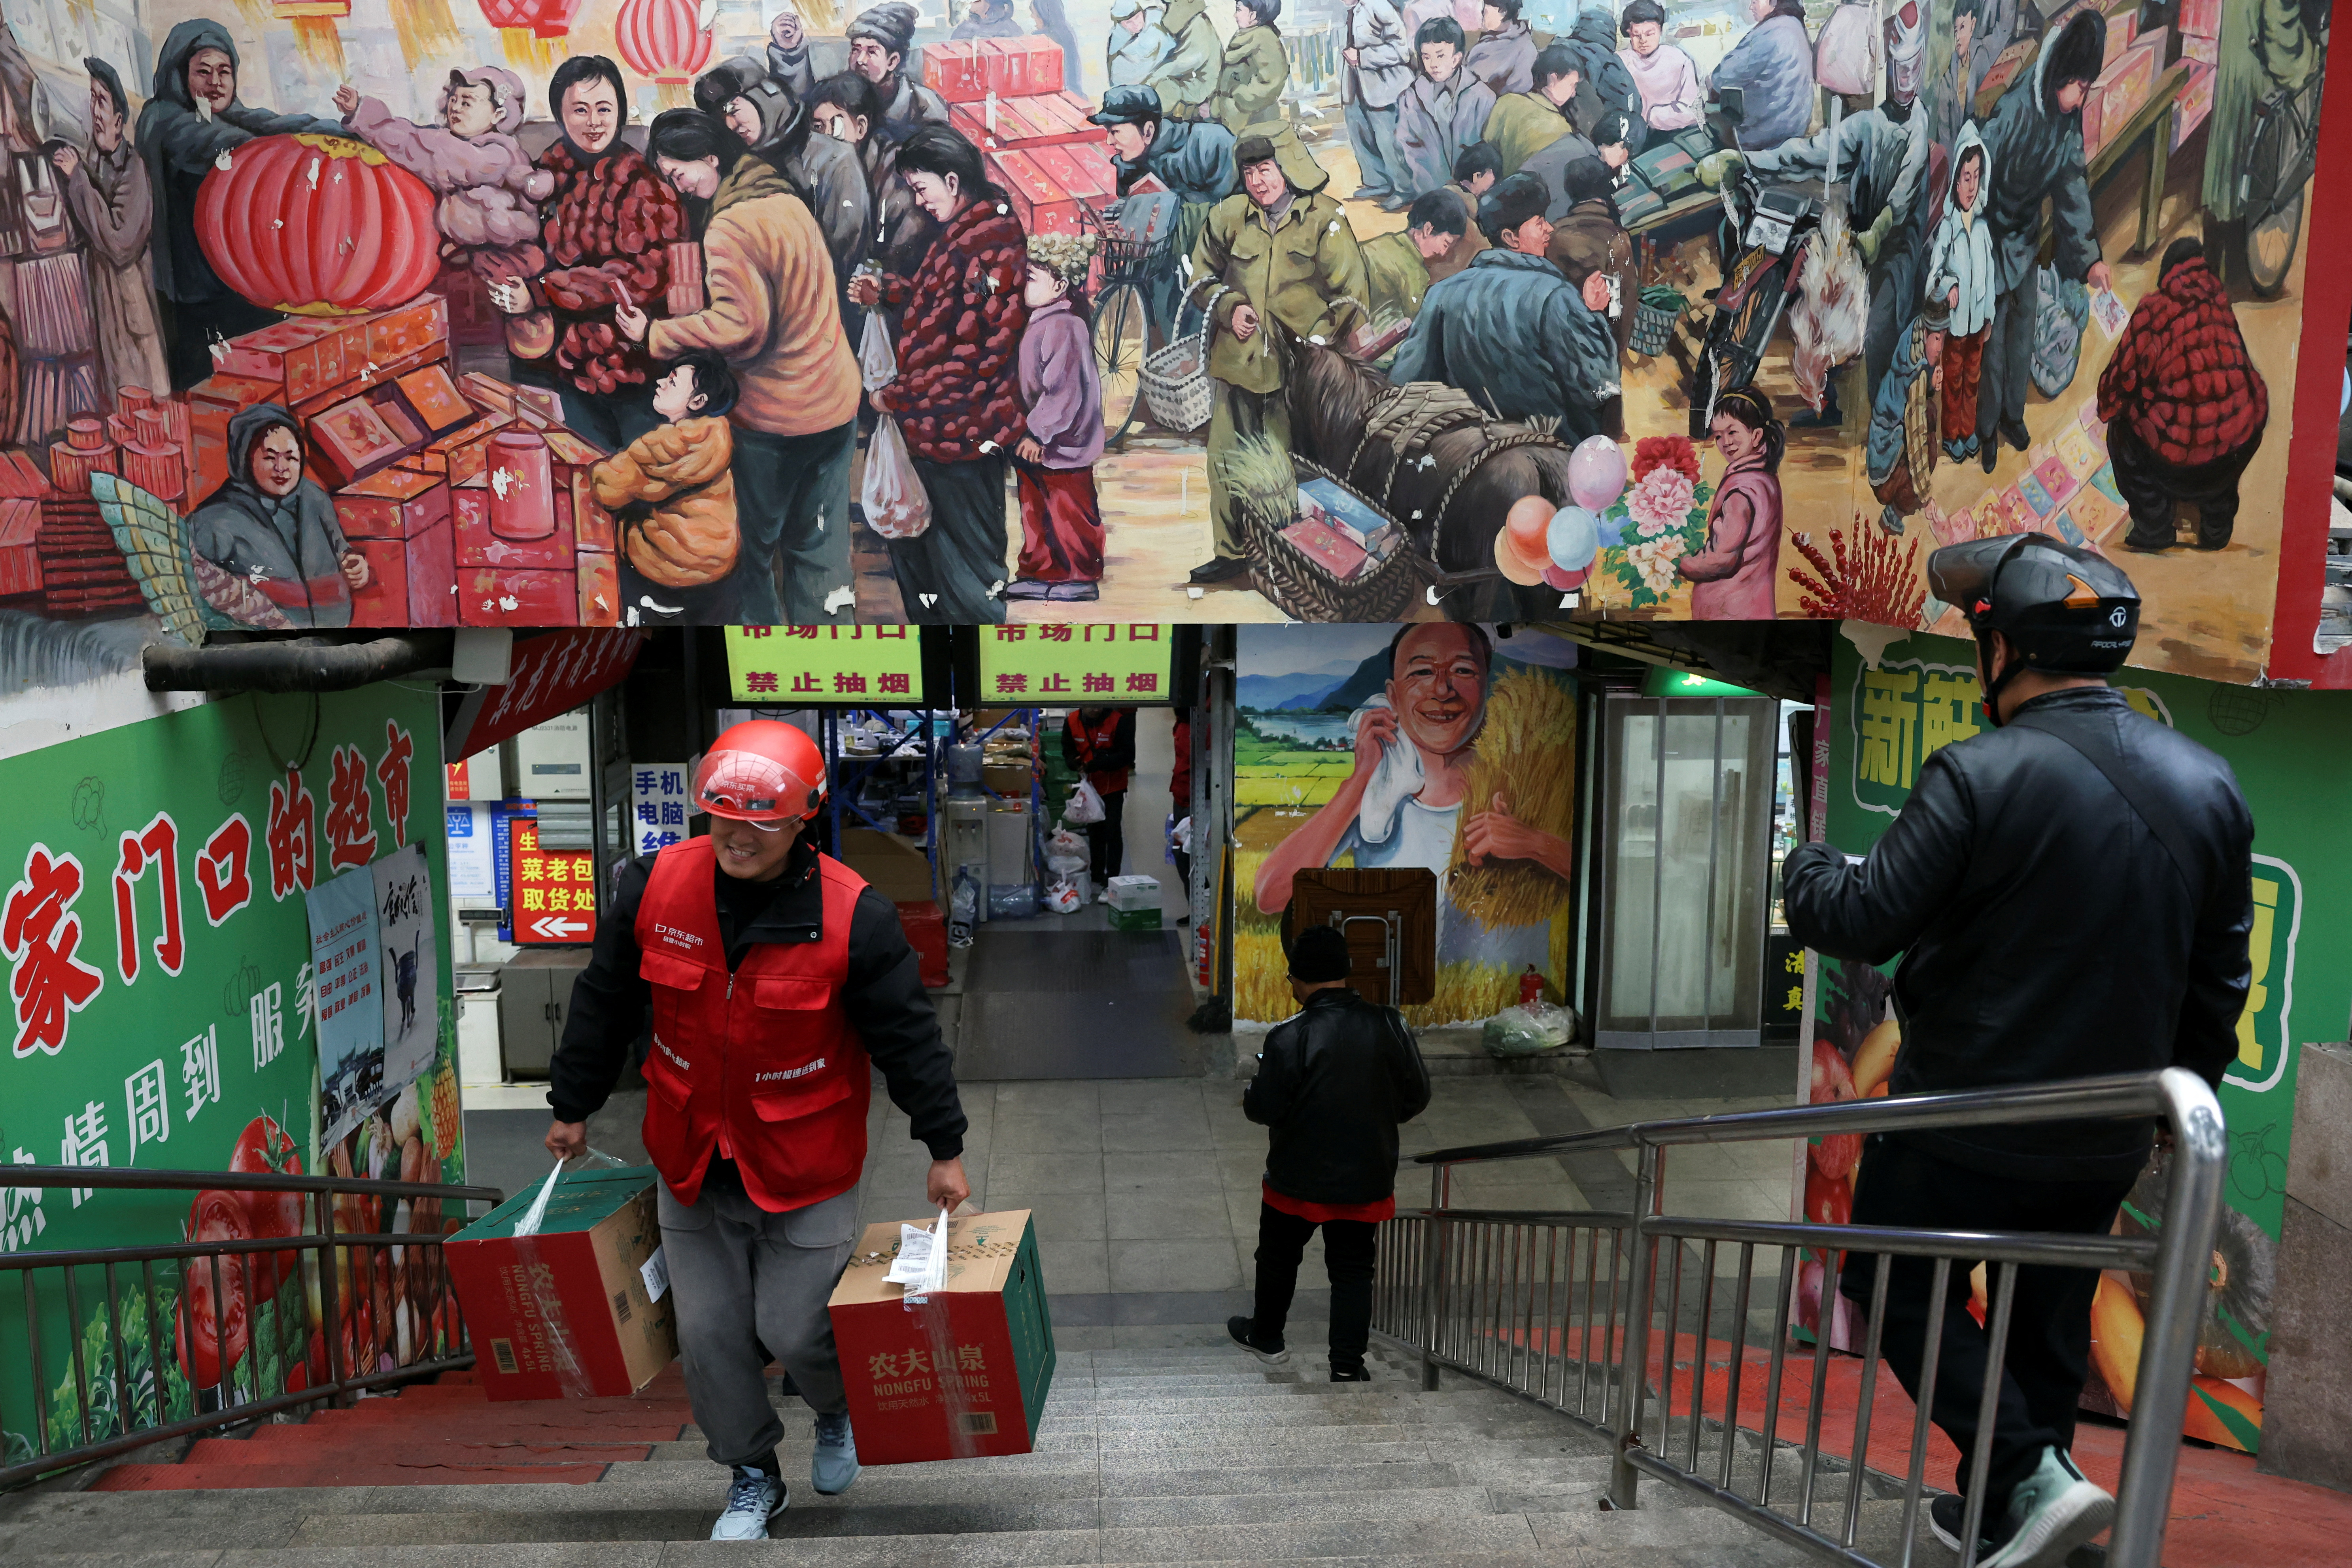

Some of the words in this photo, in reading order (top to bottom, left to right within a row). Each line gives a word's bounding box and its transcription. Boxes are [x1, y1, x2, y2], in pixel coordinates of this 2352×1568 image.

[743, 625, 905, 639] 市场门口
[995, 624, 1158, 642] 市场门口
[746, 672, 909, 693] 禁止抽烟
[996, 673, 1157, 693] 禁止抽烟
[635, 771, 683, 795] 手机
[721, 780, 756, 793] 京东买菜
[638, 801, 684, 825] 电脑
[521, 858, 593, 882] 菜老包
[3, 720, 412, 1057] 家门口的超市
[522, 887, 595, 911] 取货处
[315, 911, 367, 945] 社会主义核心价值观
[668, 927, 704, 946] 京东超市
[663, 936, 691, 950] 自营小时购
[319, 958, 332, 975] 富强
[334, 952, 344, 967] 民主
[320, 982, 332, 998] 自由
[335, 974, 346, 989] 平等
[348, 967, 357, 983] 公正
[1783, 950, 1805, 1011] 清真
[321, 1005, 332, 1022] 爱国
[755, 1058, 826, 1082] 1小时极速送到家
[499, 1266, 518, 1314] 饮用天然水
[512, 1265, 536, 1318] NONGFU
[528, 1324, 552, 1372] SPRING
[527, 1263, 577, 1372] 农夫山泉
[869, 1344, 986, 1380] 农夫山泉
[873, 1377, 932, 1396] NONGFU
[938, 1375, 989, 1389] SPRING
[877, 1396, 929, 1411] 饮用天然水
